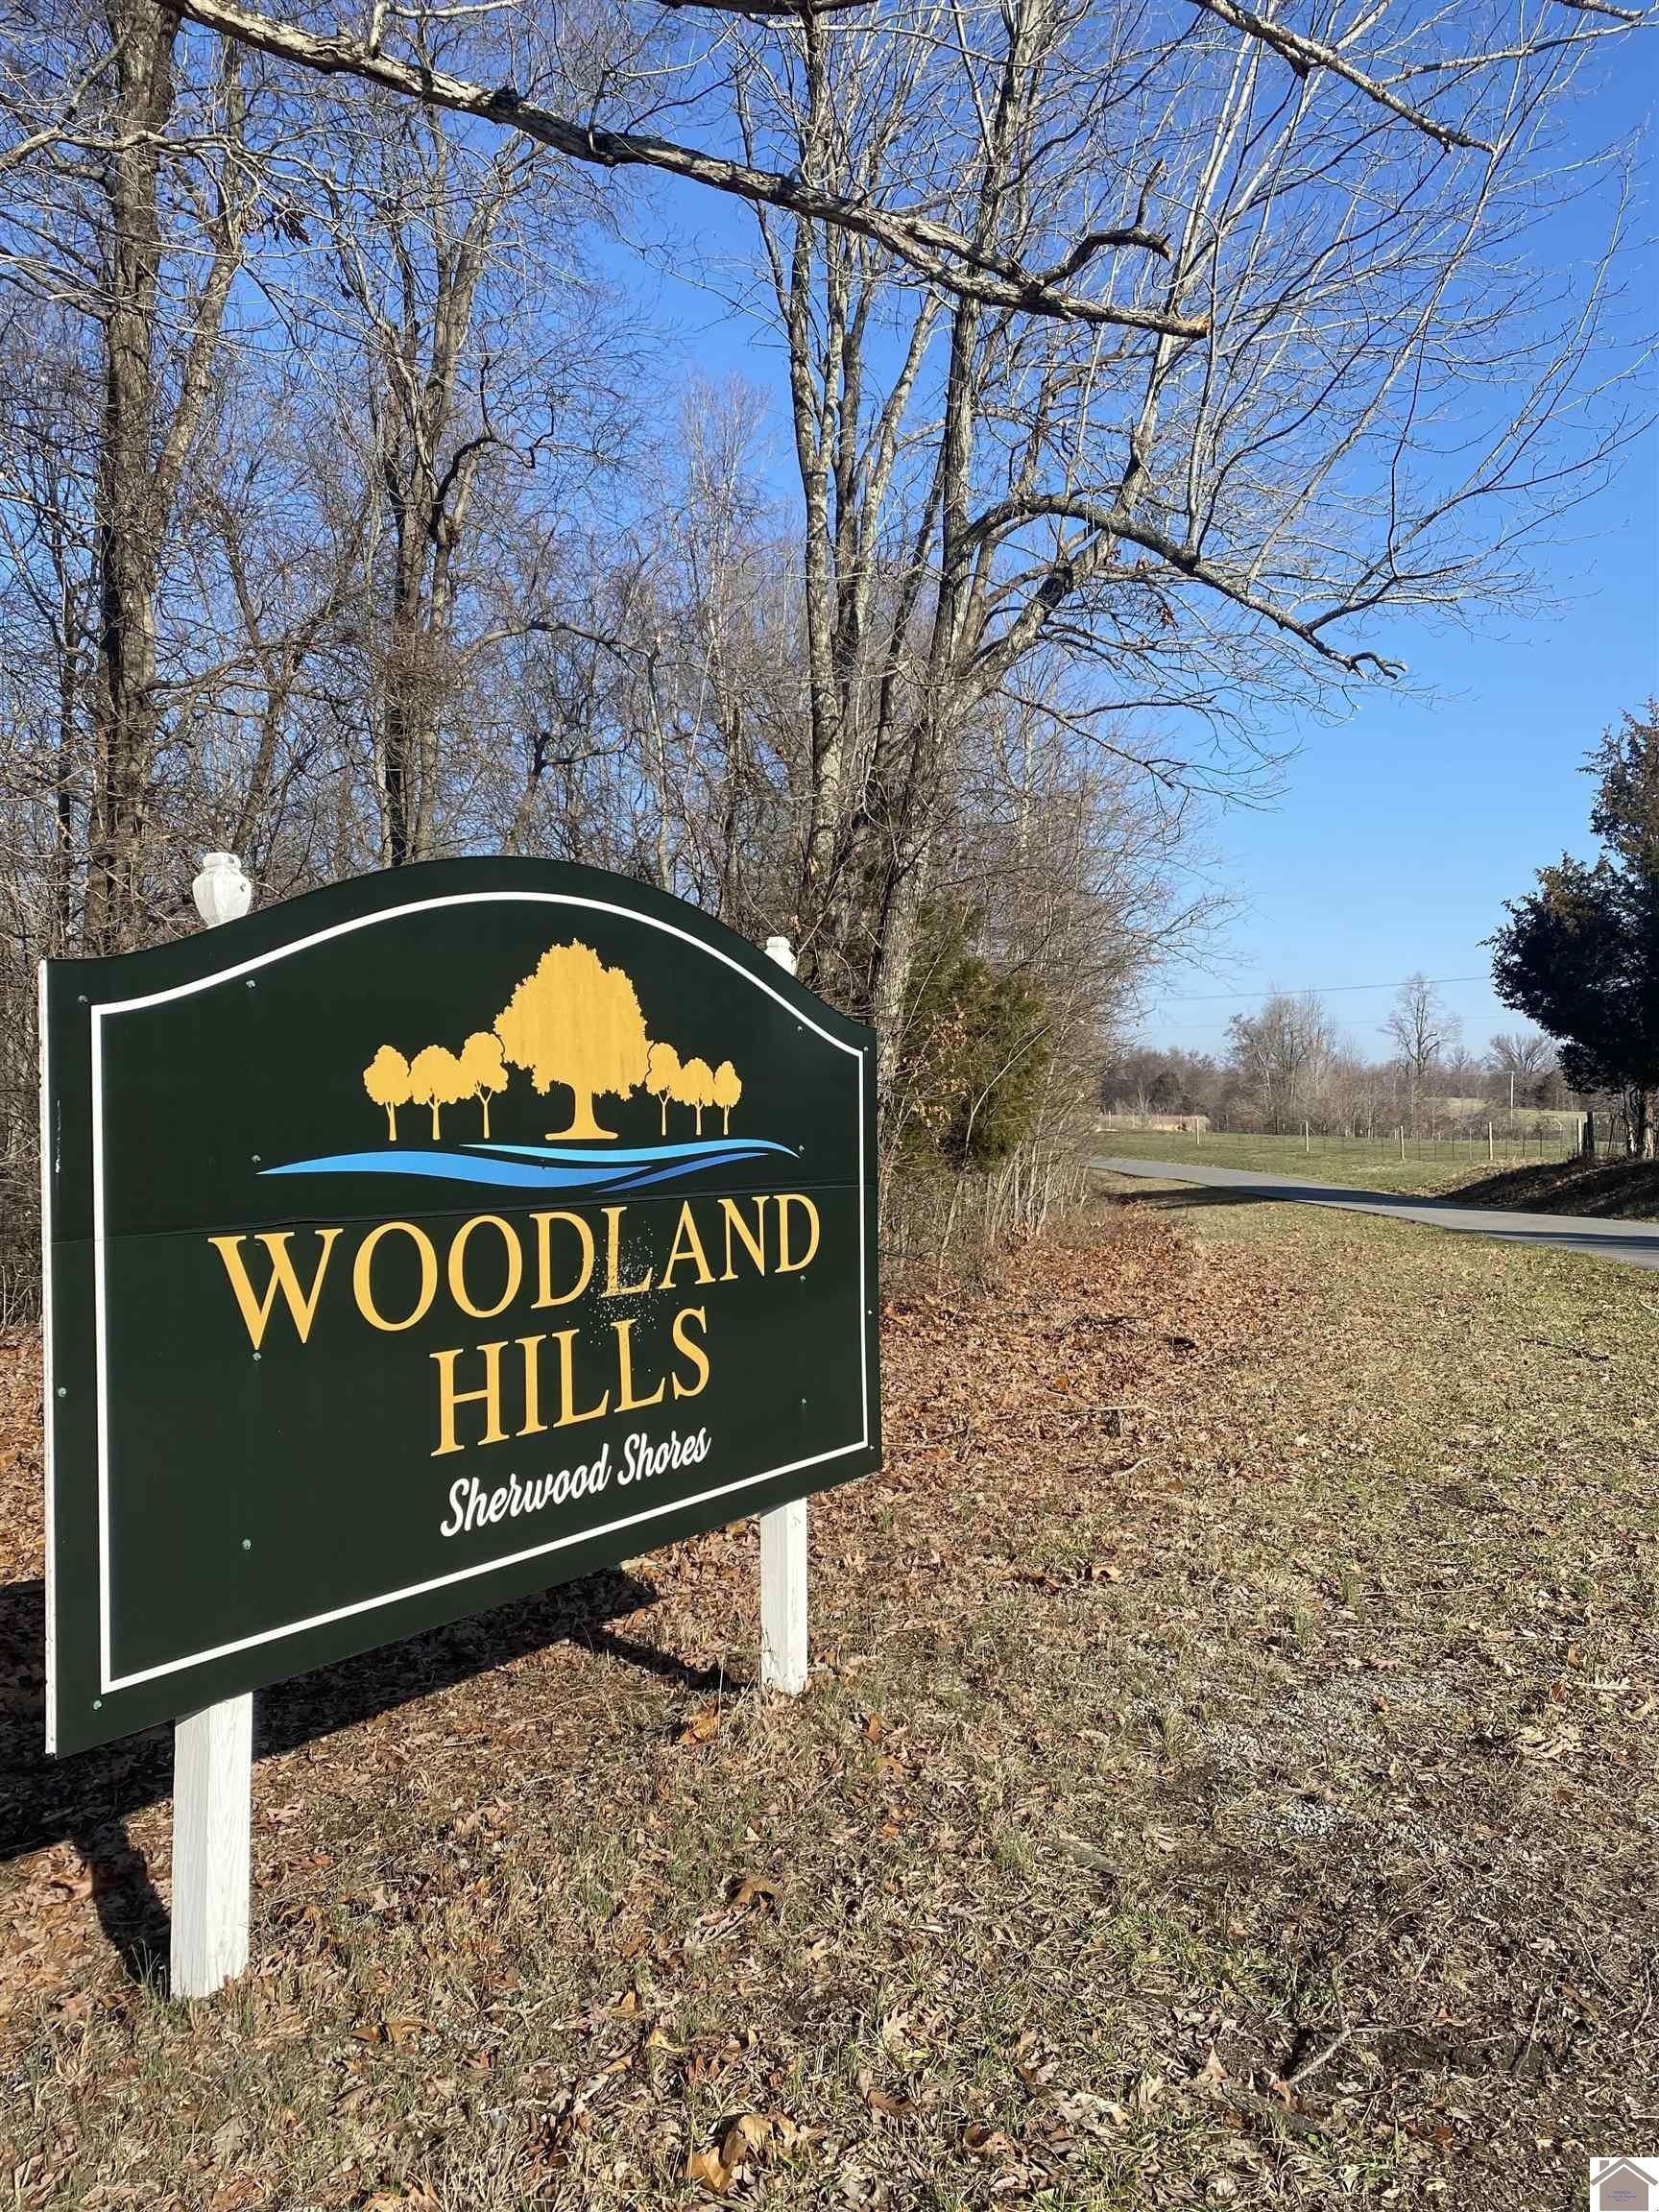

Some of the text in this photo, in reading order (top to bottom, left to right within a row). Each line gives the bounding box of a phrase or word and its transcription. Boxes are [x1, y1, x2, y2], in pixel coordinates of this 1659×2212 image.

[207, 1193, 820, 1350] WOODLAND
[429, 1306, 710, 1456] HILLS
[440, 1427, 711, 1537] Sherwood Shores
